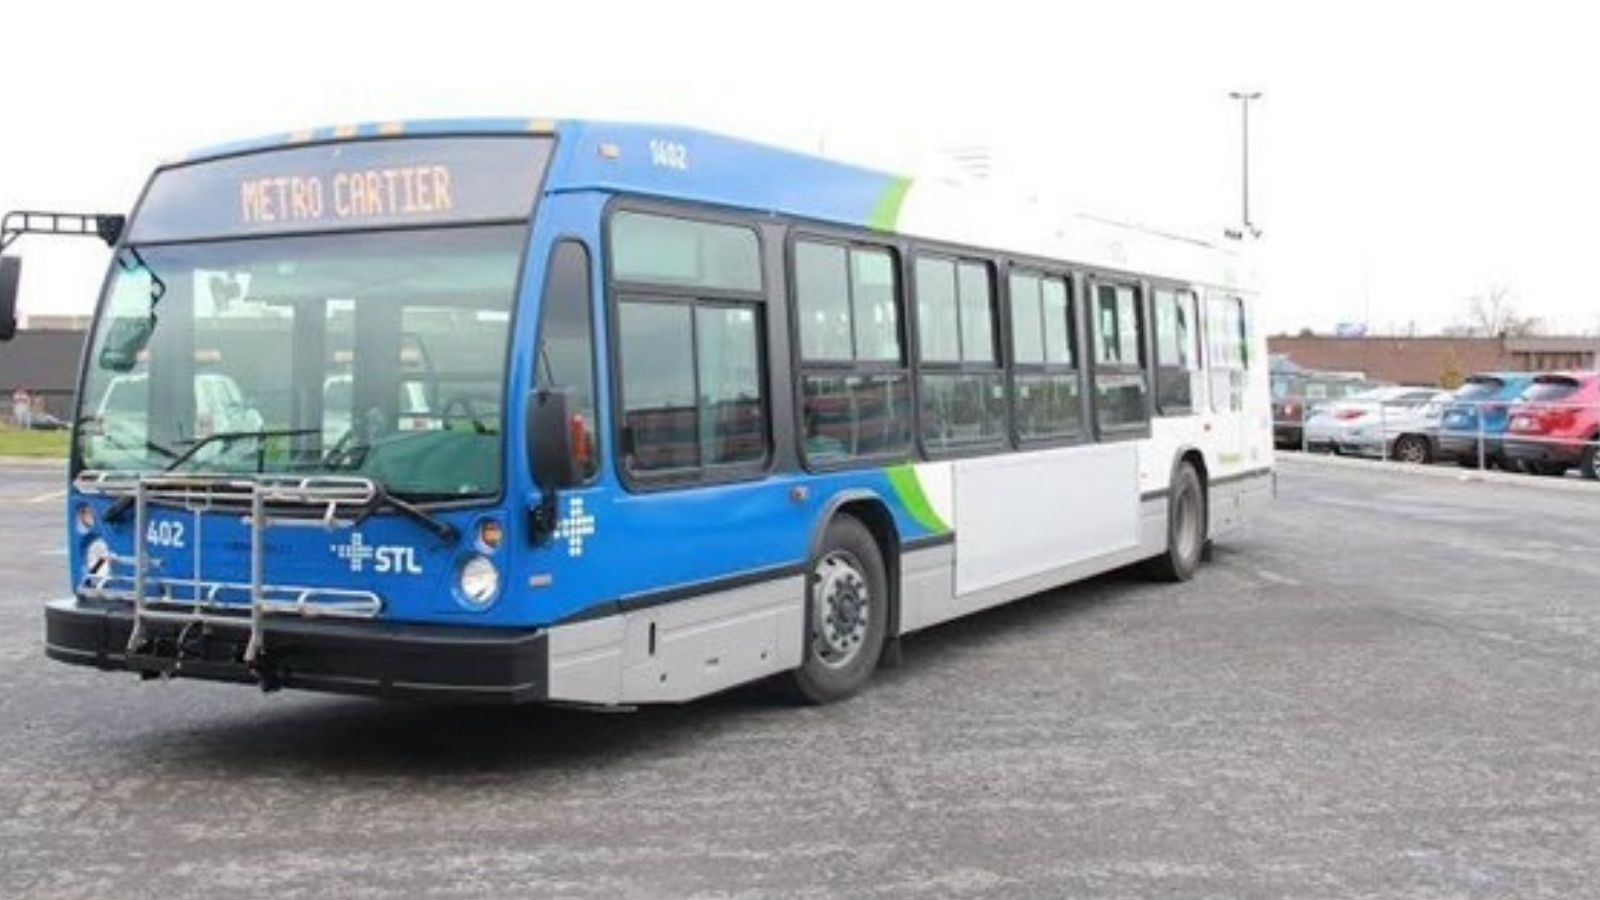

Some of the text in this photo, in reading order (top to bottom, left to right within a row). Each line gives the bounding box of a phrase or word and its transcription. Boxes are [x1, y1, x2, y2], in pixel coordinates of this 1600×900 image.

[240, 164, 453, 222] METRO CARTIER
[374, 545, 422, 574] STL
